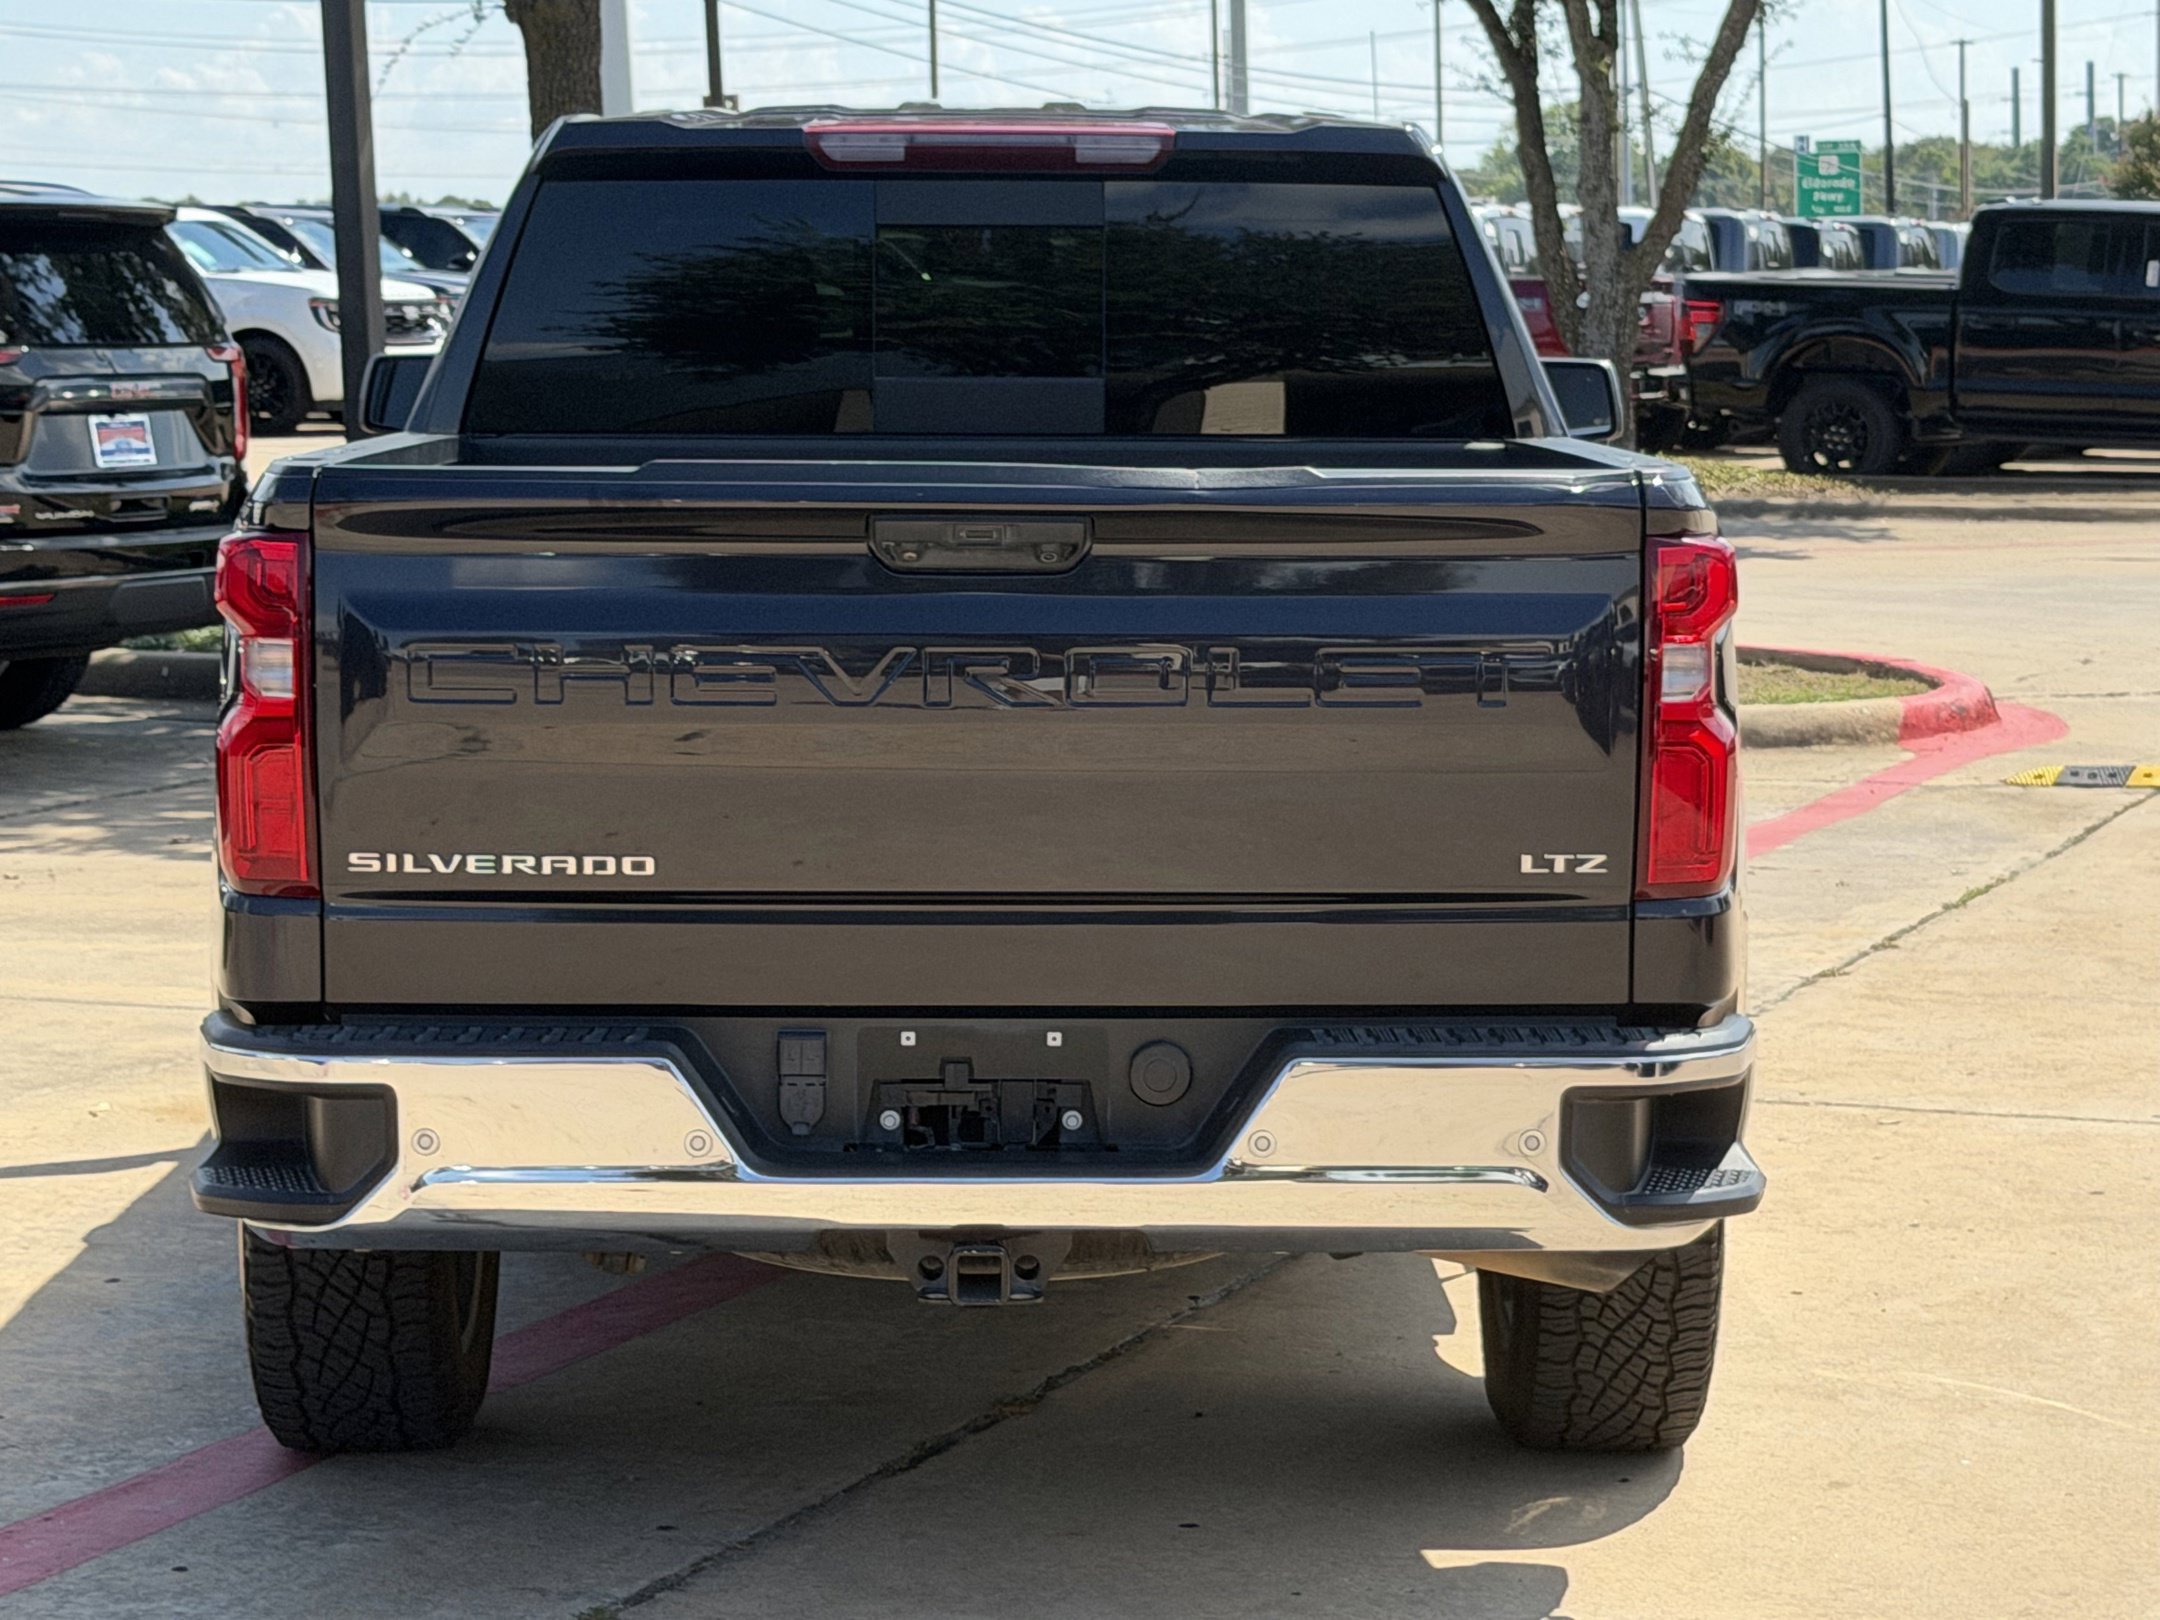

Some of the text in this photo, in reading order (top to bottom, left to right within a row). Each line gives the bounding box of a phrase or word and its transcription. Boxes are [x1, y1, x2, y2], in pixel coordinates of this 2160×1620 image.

[408, 642, 1553, 709] CHEVROLET
[347, 852, 656, 876] SILVERADO
[1520, 853, 1609, 874] LTZ
